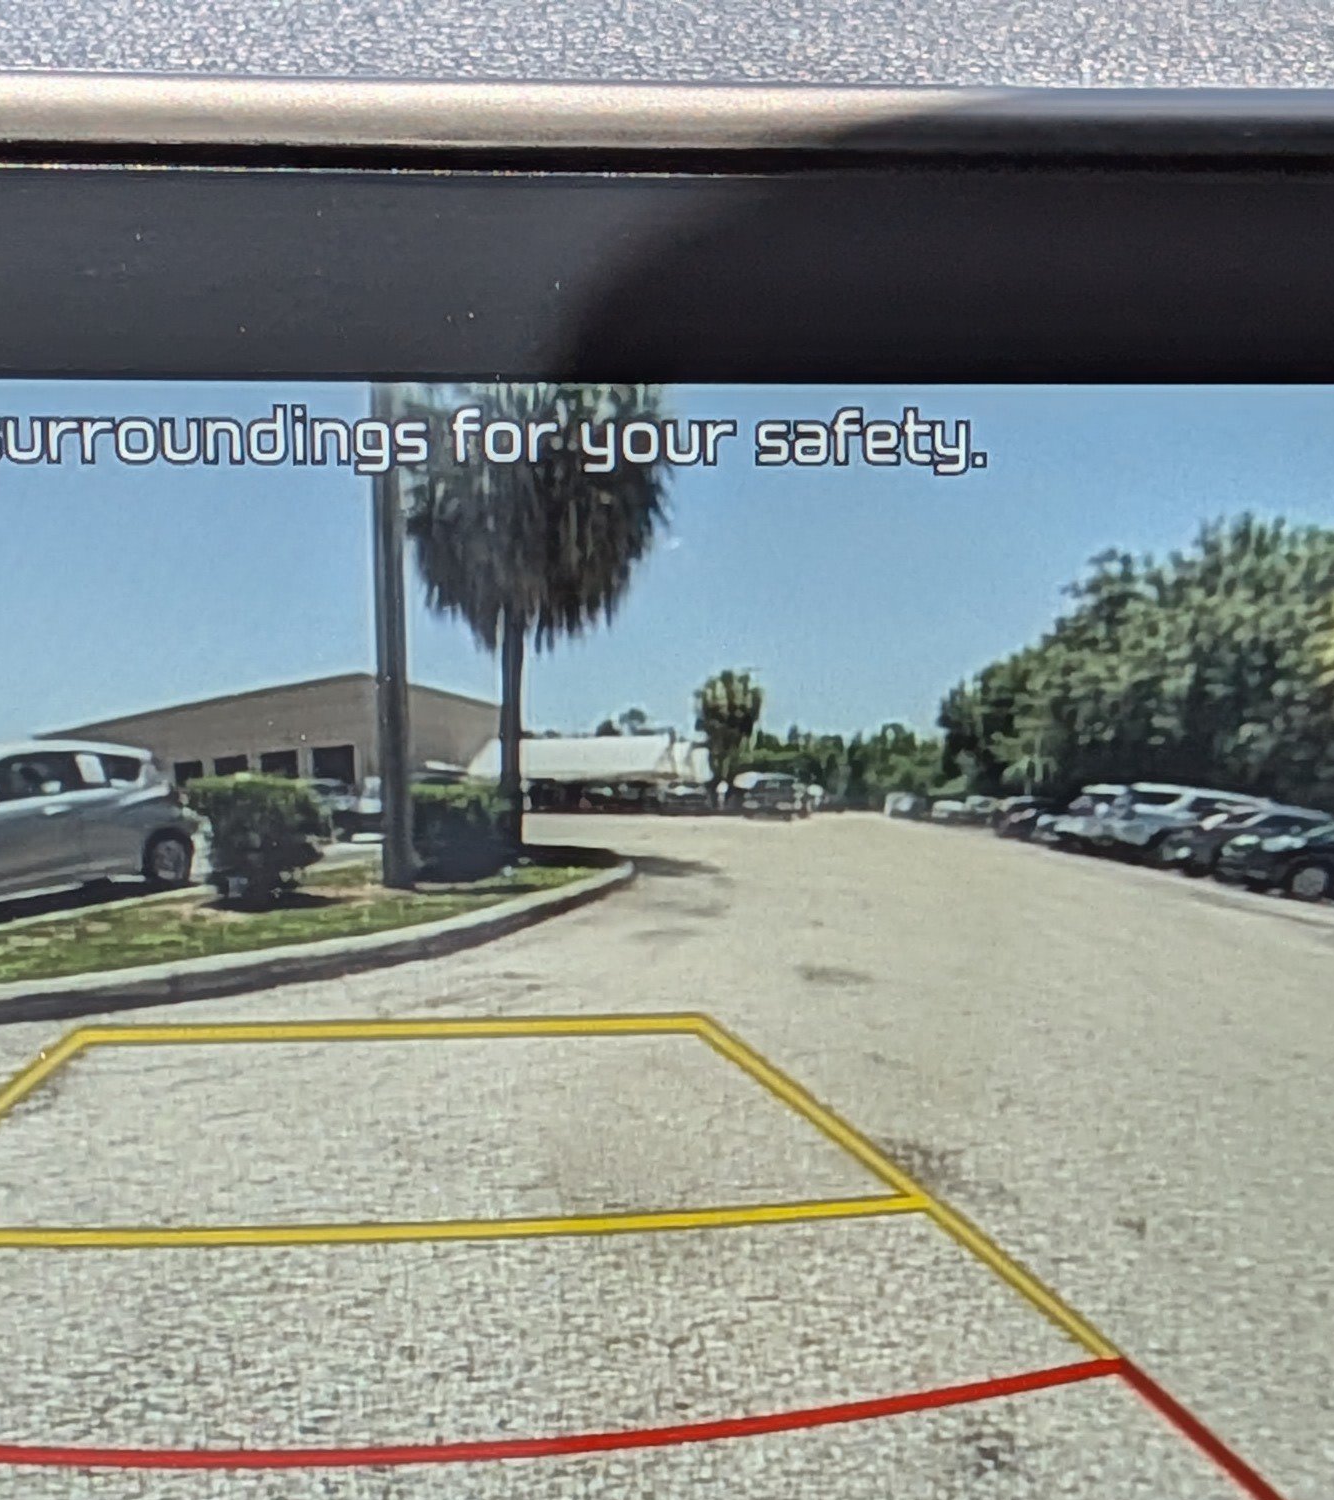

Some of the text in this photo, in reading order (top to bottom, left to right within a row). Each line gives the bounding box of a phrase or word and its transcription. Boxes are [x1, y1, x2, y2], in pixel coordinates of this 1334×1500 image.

[452, 406, 558, 465] for
[580, 419, 736, 474] your
[755, 406, 988, 476] safety.
